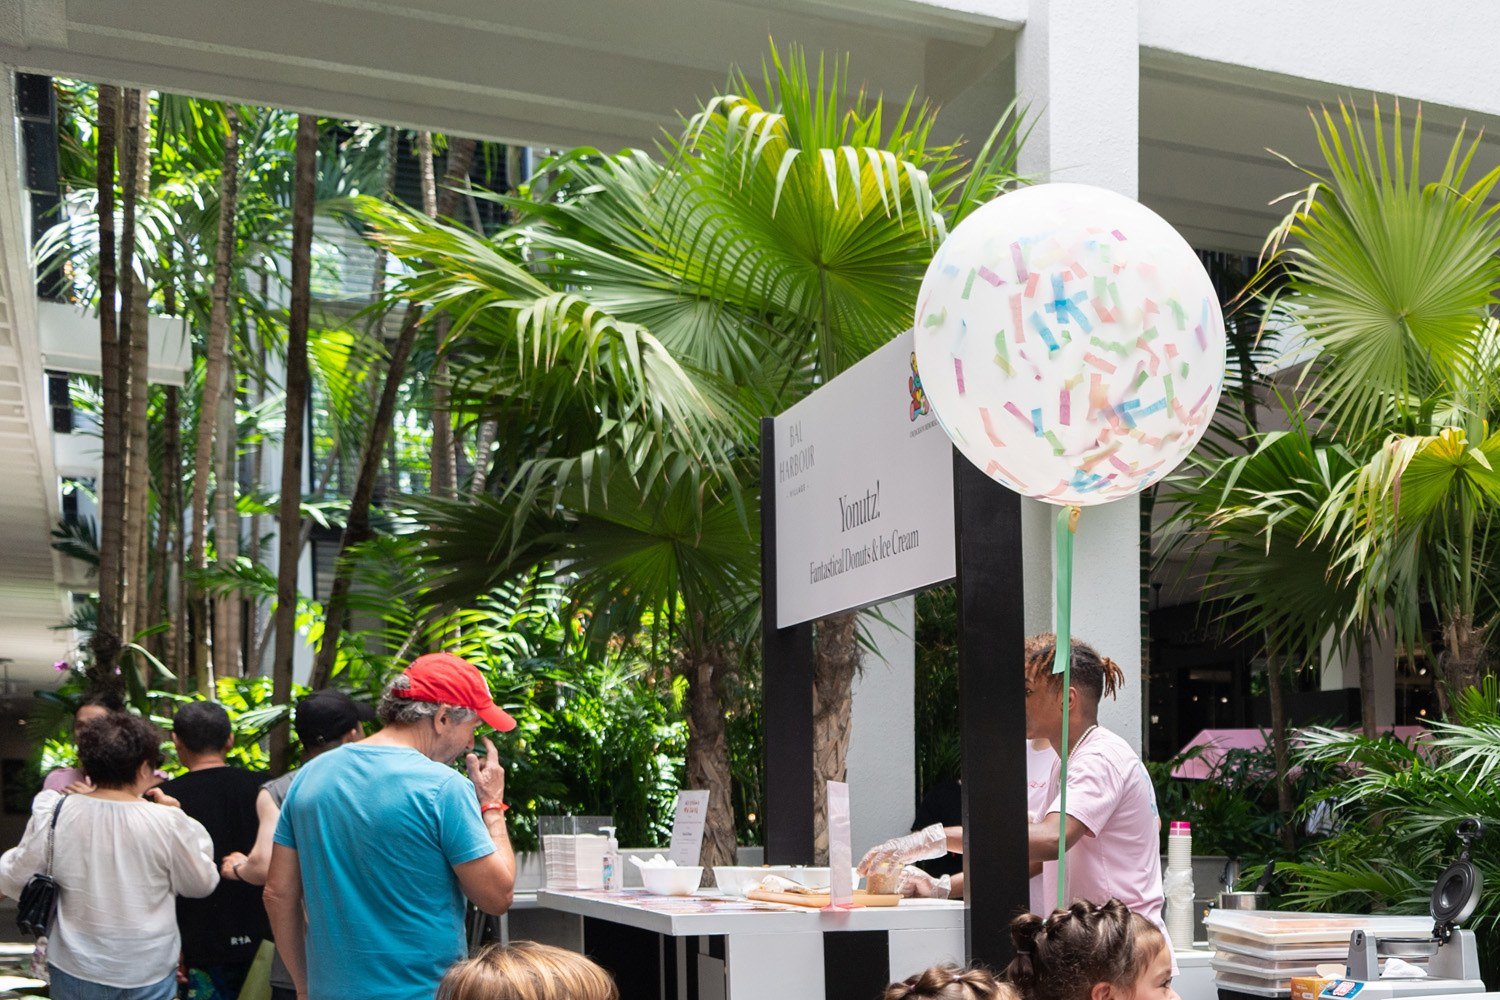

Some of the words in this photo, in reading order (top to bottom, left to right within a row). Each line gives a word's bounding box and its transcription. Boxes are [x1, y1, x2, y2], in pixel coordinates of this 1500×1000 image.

[789, 420, 802, 448] BAL
[780, 445, 815, 483] HARBOUR
[839, 480, 880, 532] Yonutz!
[810, 548, 844, 584] Fantastical
[845, 545, 871, 572] Donuts
[872, 538, 879, 562] &
[879, 535, 891, 559] Ice
[892, 529, 919, 555] Cream
